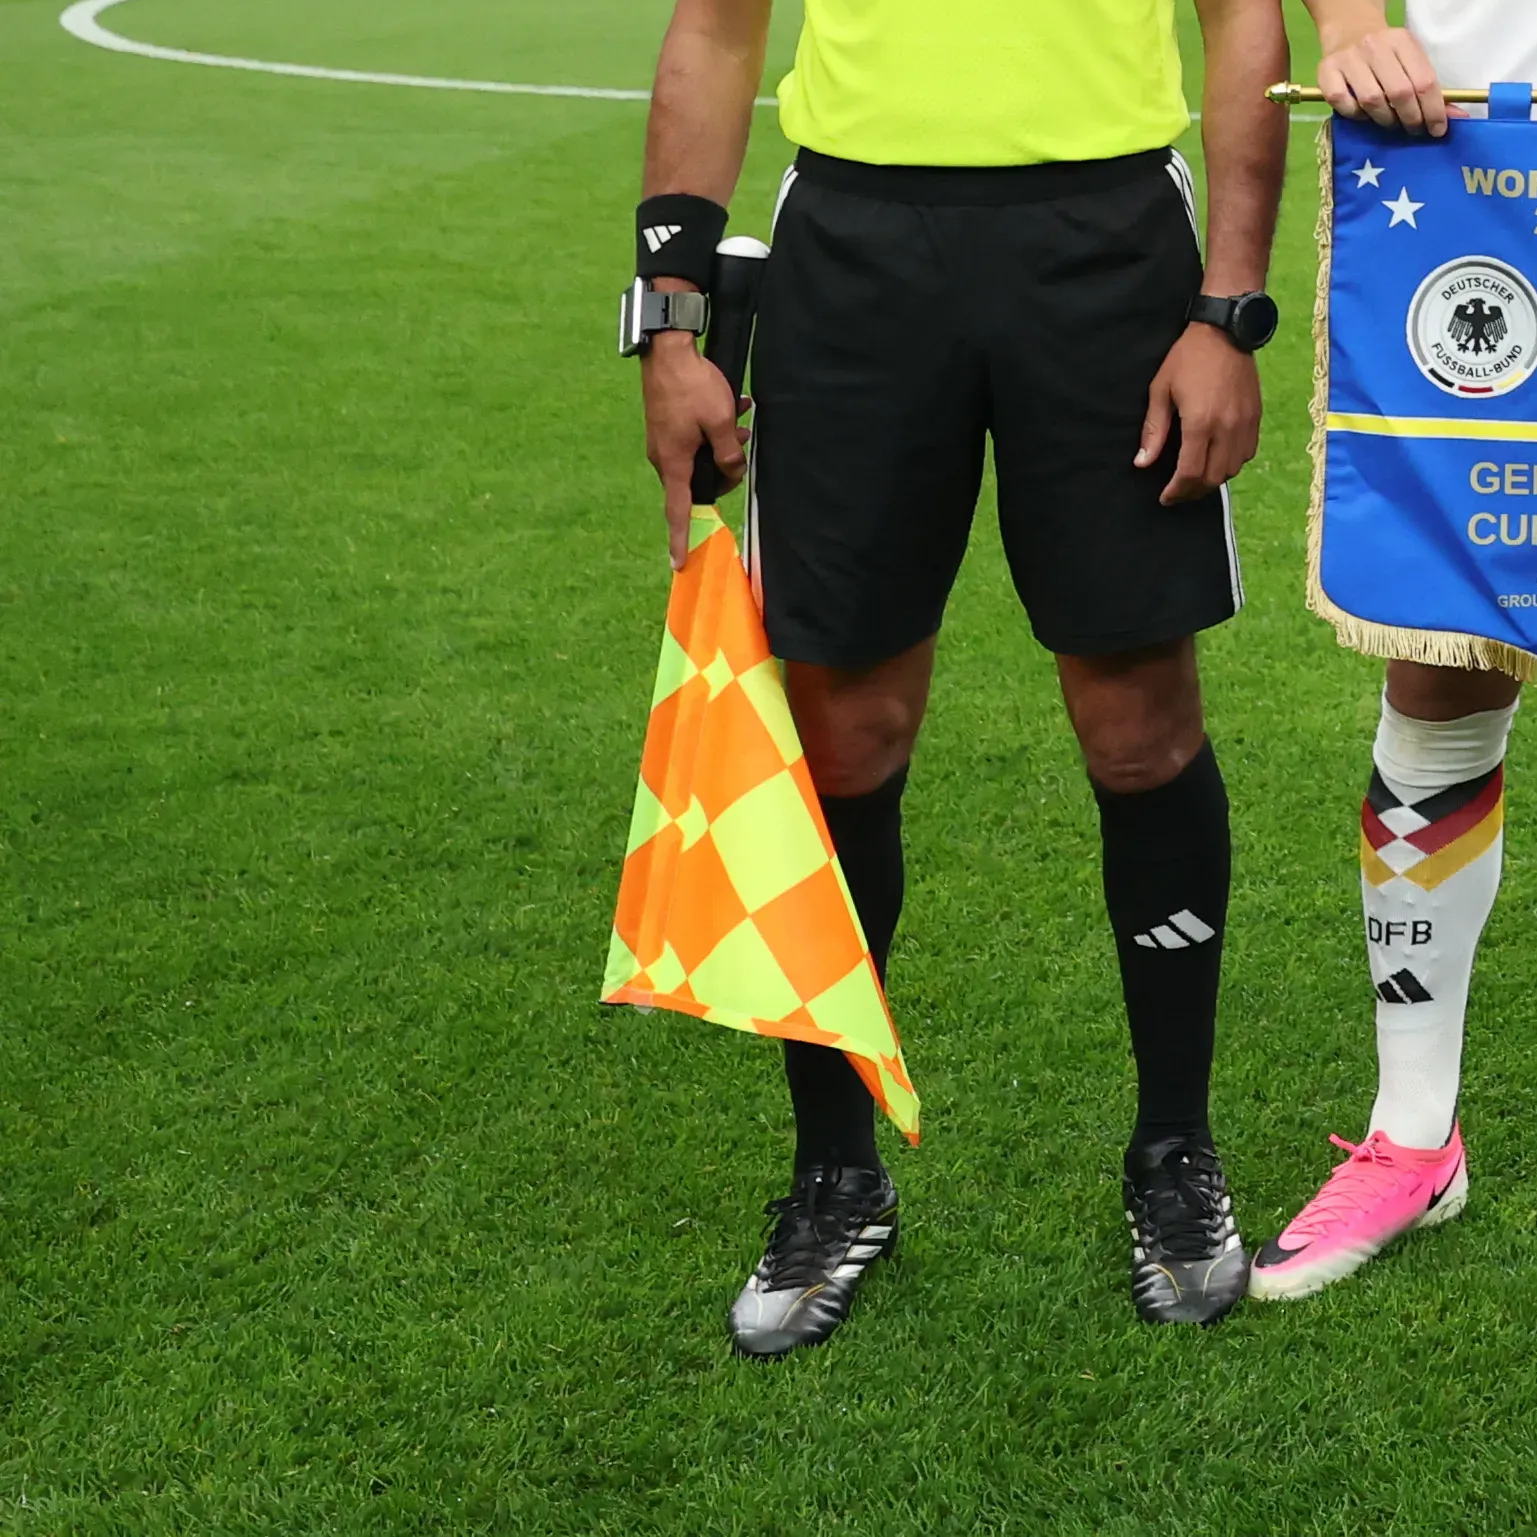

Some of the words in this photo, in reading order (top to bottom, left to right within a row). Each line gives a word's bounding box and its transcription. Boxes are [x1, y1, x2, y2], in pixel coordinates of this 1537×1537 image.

[1442, 277, 1515, 305] DEUTSCHER
[1431, 341, 1523, 379] FUSSBALL-BUND
[1368, 916, 1433, 946] DFB
